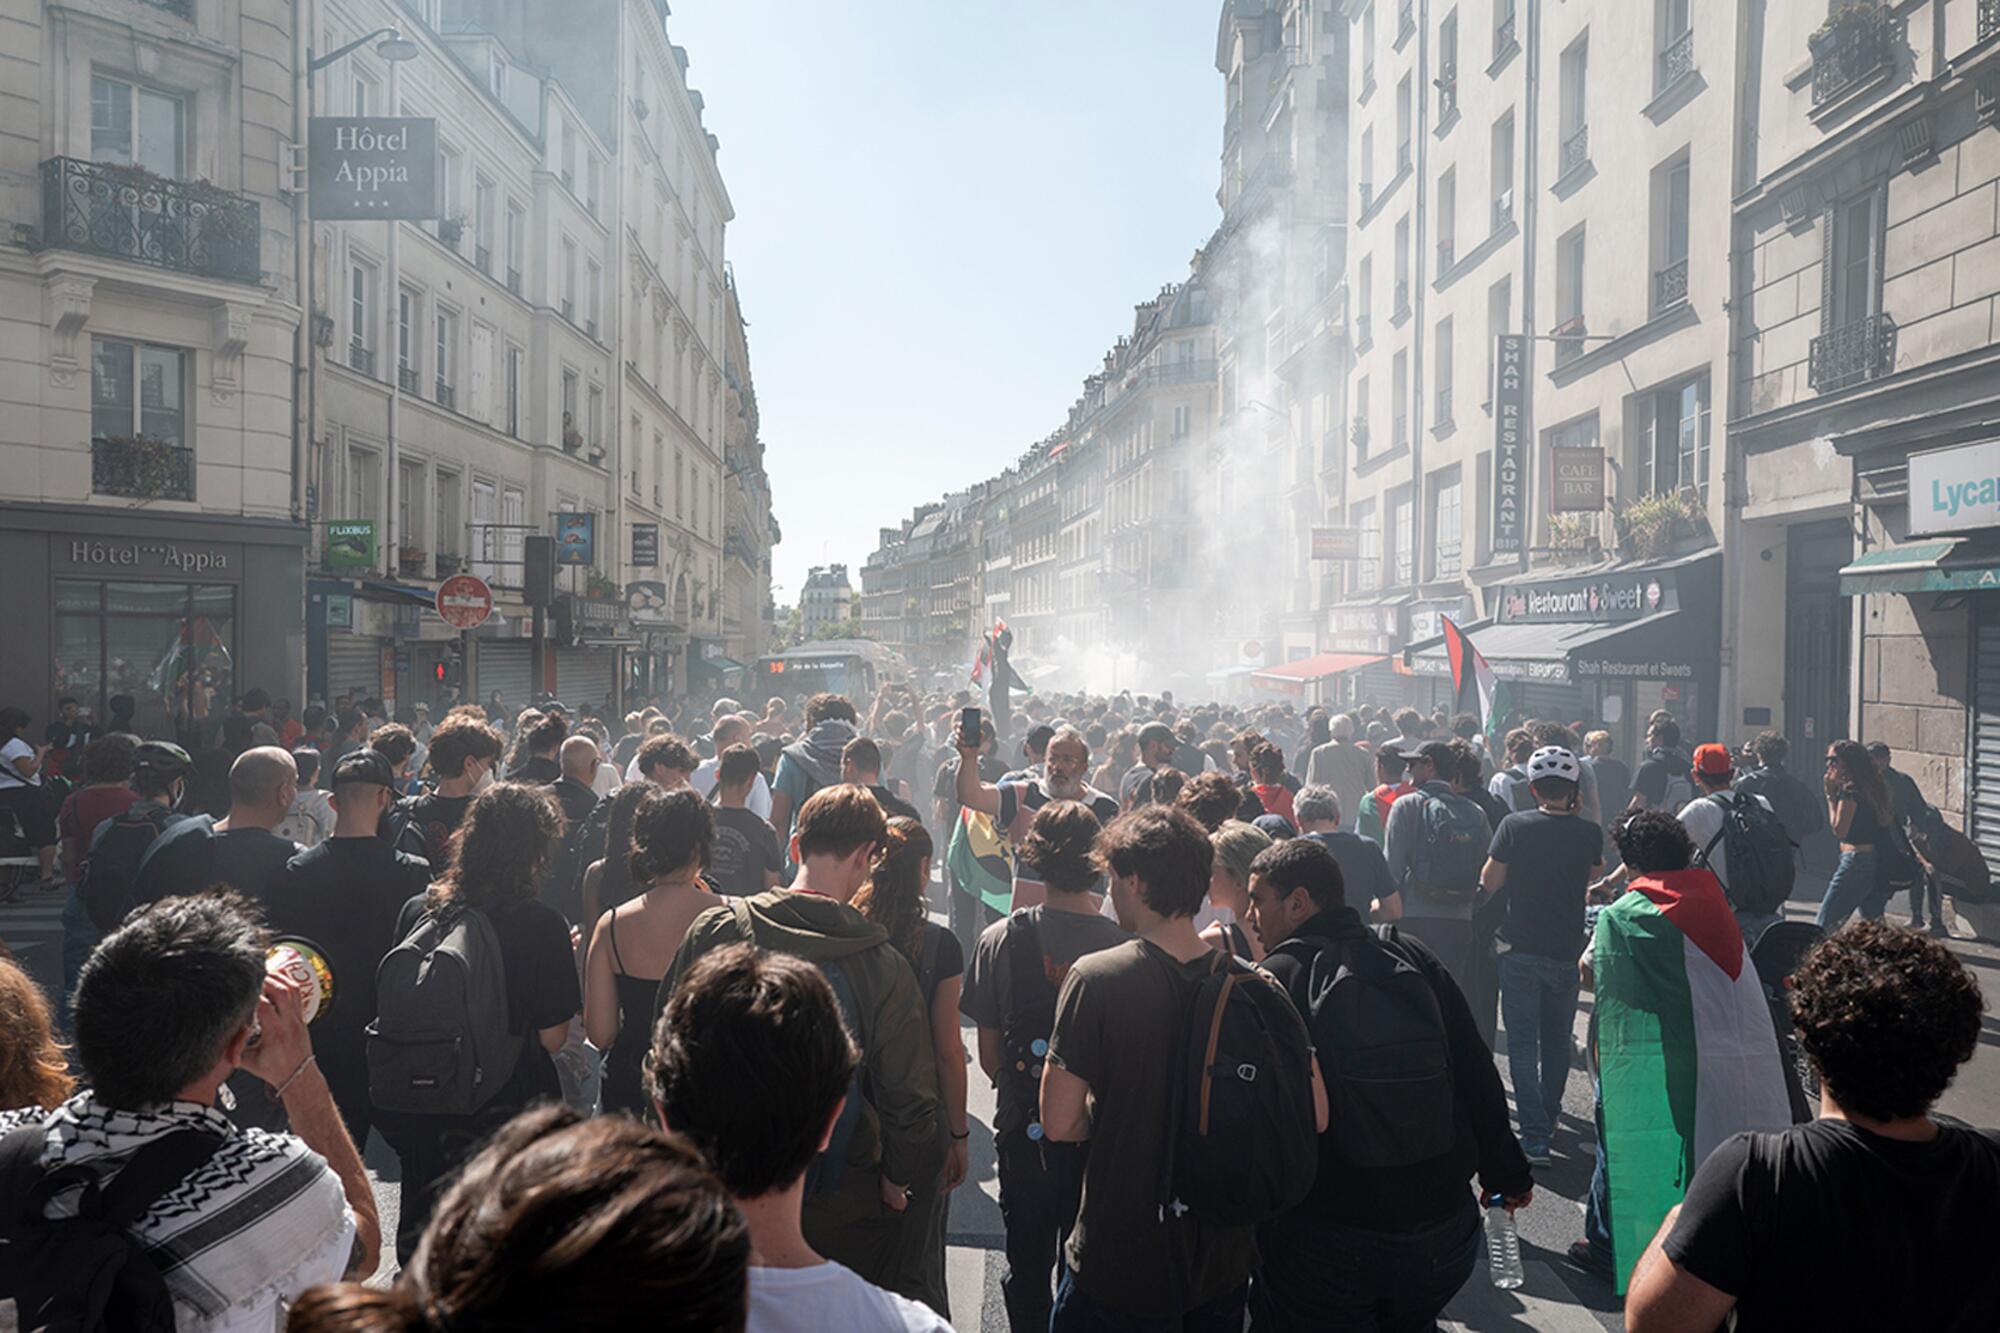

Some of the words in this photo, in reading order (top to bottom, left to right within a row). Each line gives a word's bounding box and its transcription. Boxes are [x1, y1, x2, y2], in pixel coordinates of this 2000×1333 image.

[335, 126, 407, 151] Hôtel
[335, 160, 408, 191] Appia
[1503, 338, 1519, 389] SHAH
[1501, 405, 1518, 535] RESTAURANT
[1563, 482, 1593, 495] BAR
[72, 541, 138, 564] Hôtel
[164, 545, 227, 572] Appia
[1528, 587, 1588, 614] Restaurant
[1601, 583, 1641, 609] Sweet
[1578, 660, 1600, 675] Shah
[1602, 660, 1649, 676] Restaurant
[1660, 662, 1692, 677] Sweets
